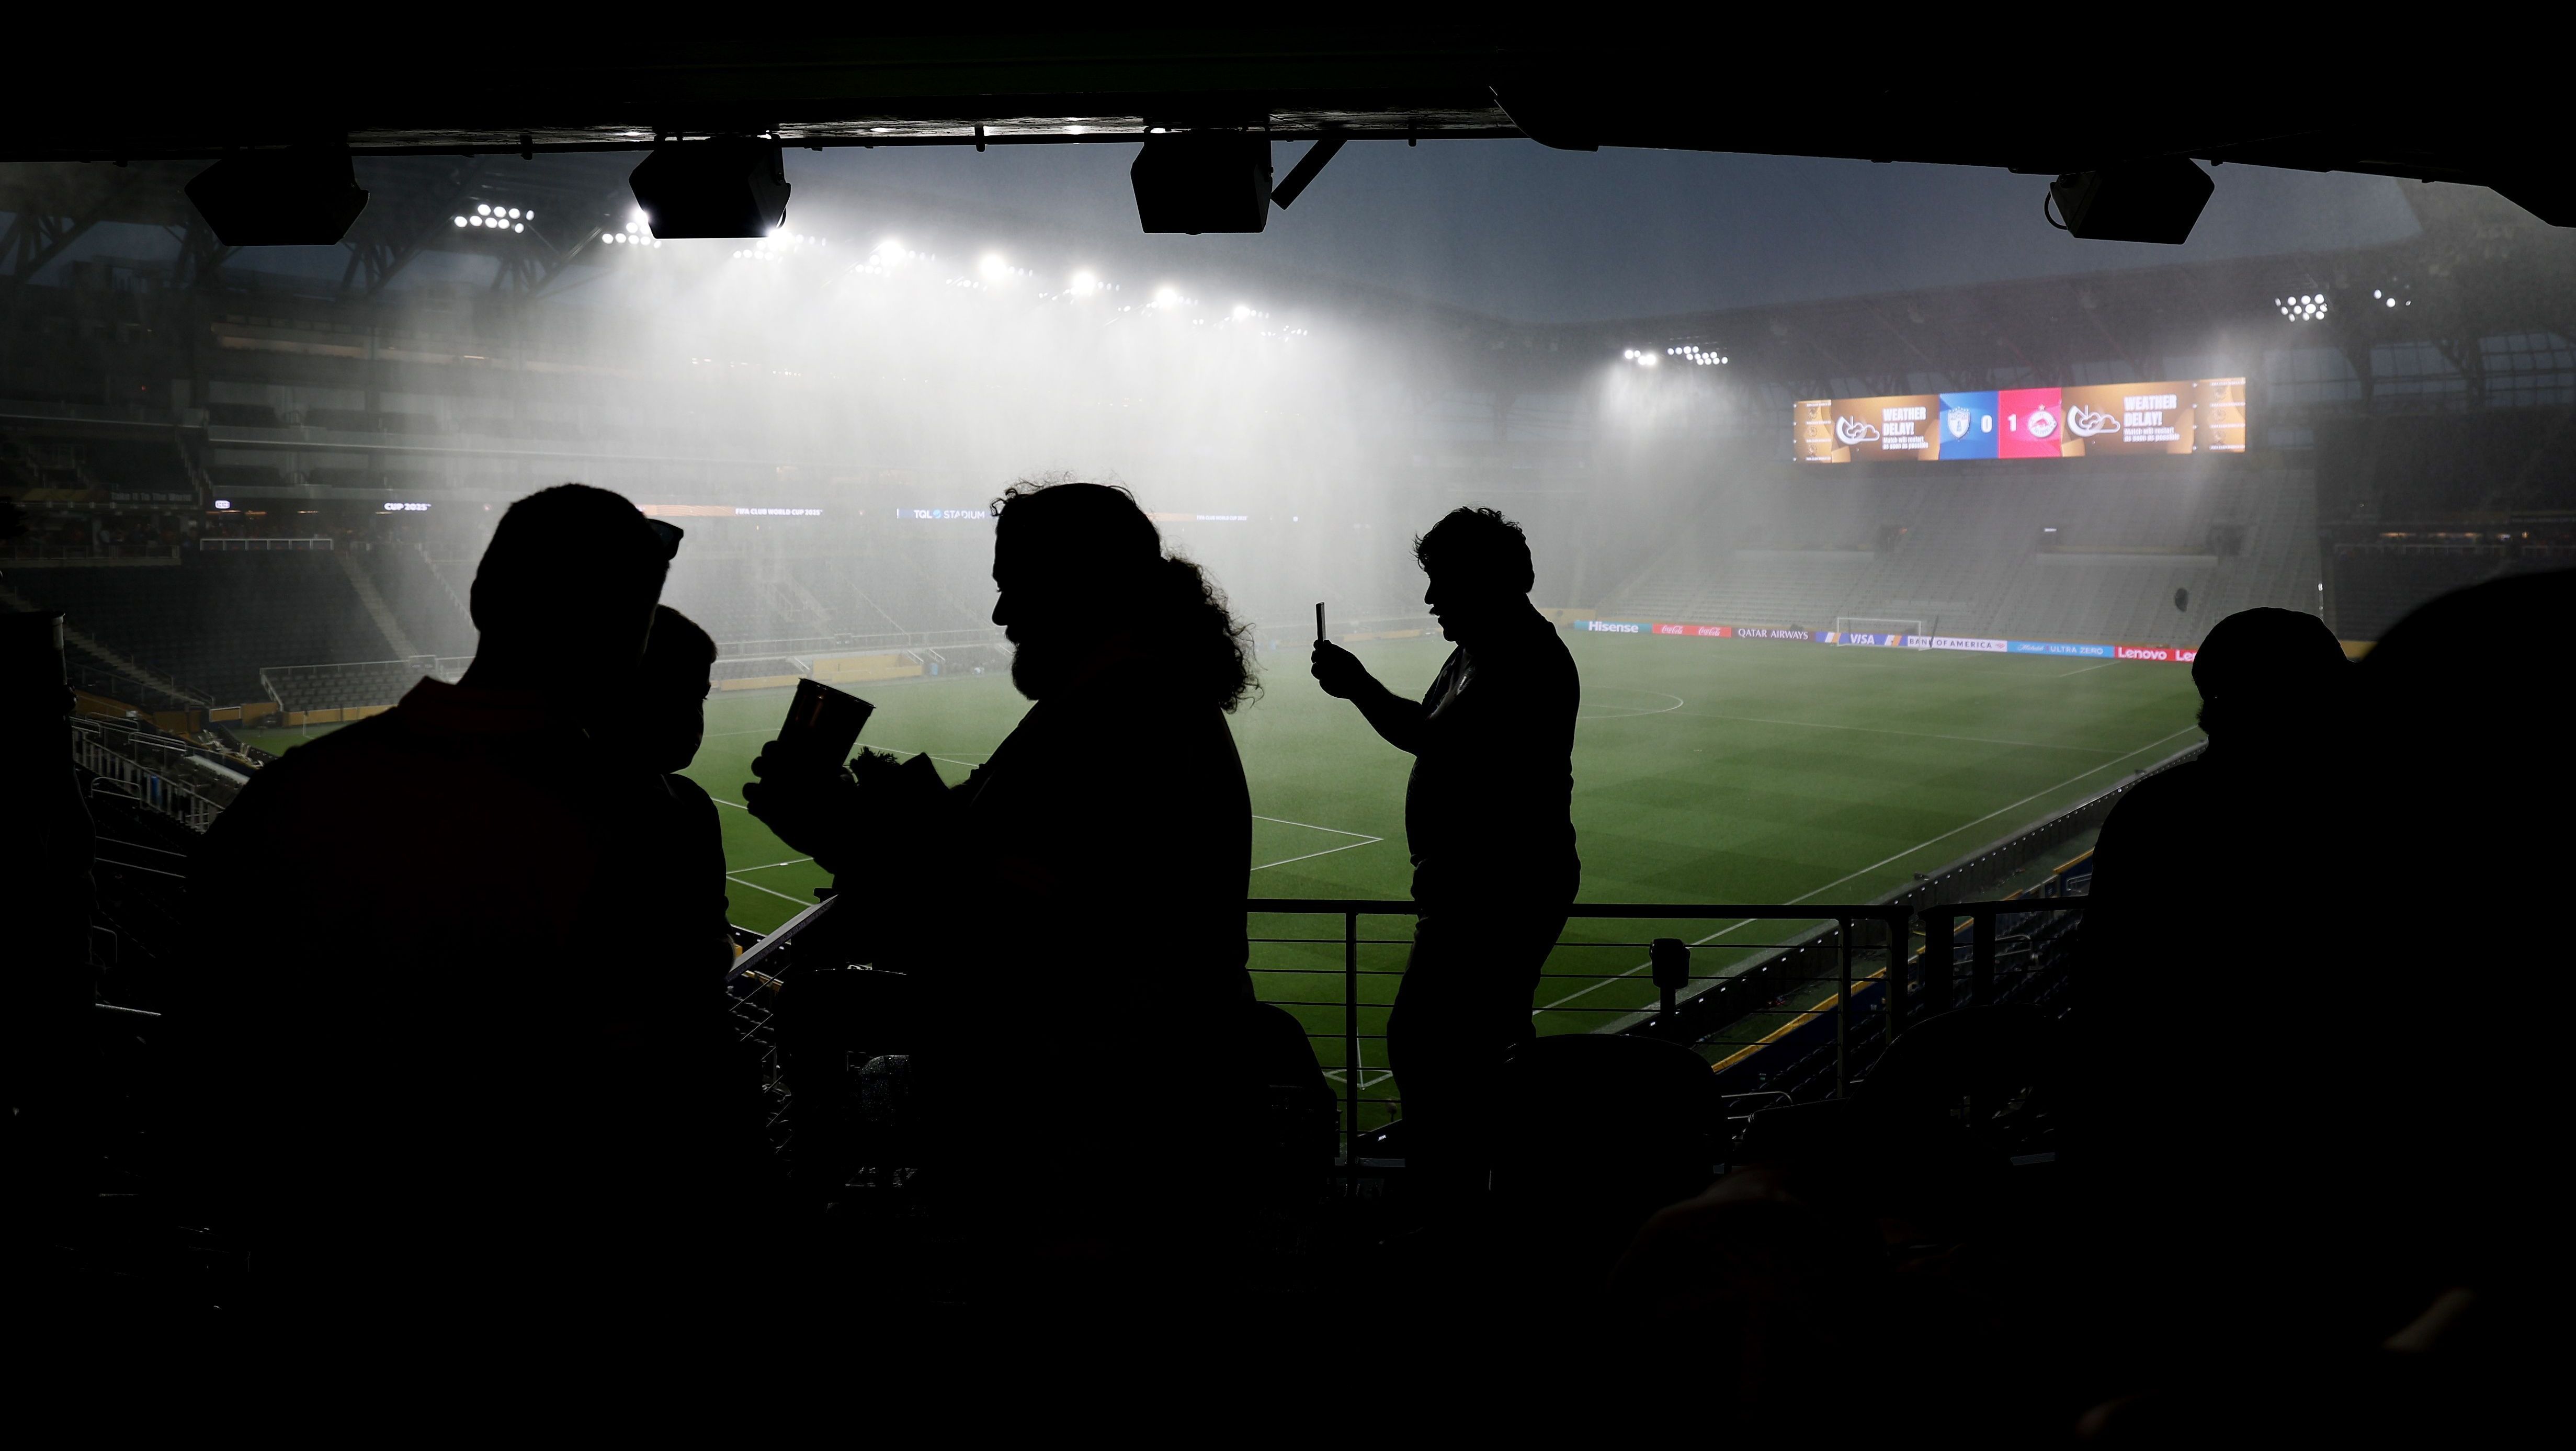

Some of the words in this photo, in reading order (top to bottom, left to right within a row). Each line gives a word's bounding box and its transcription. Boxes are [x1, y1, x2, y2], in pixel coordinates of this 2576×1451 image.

[2124, 394, 2177, 410] WEATHER
[1882, 406, 1926, 422] WEATHER
[2124, 411, 2162, 426] DELAY!
[1882, 422, 1914, 436] DELAY!
[1981, 415, 1992, 433] 0
[2007, 414, 2017, 432] 1
[2155, 434, 2180, 442] possible
[913, 509, 932, 519] TQL
[944, 511, 984, 519] STADIUM
[1588, 621, 1639, 633] Hisense
[1738, 628, 1767, 638] QATAR
[1771, 630, 1808, 640] AIRWAYS
[1850, 633, 1875, 644] VISA
[2118, 647, 2168, 660] Lenovo
